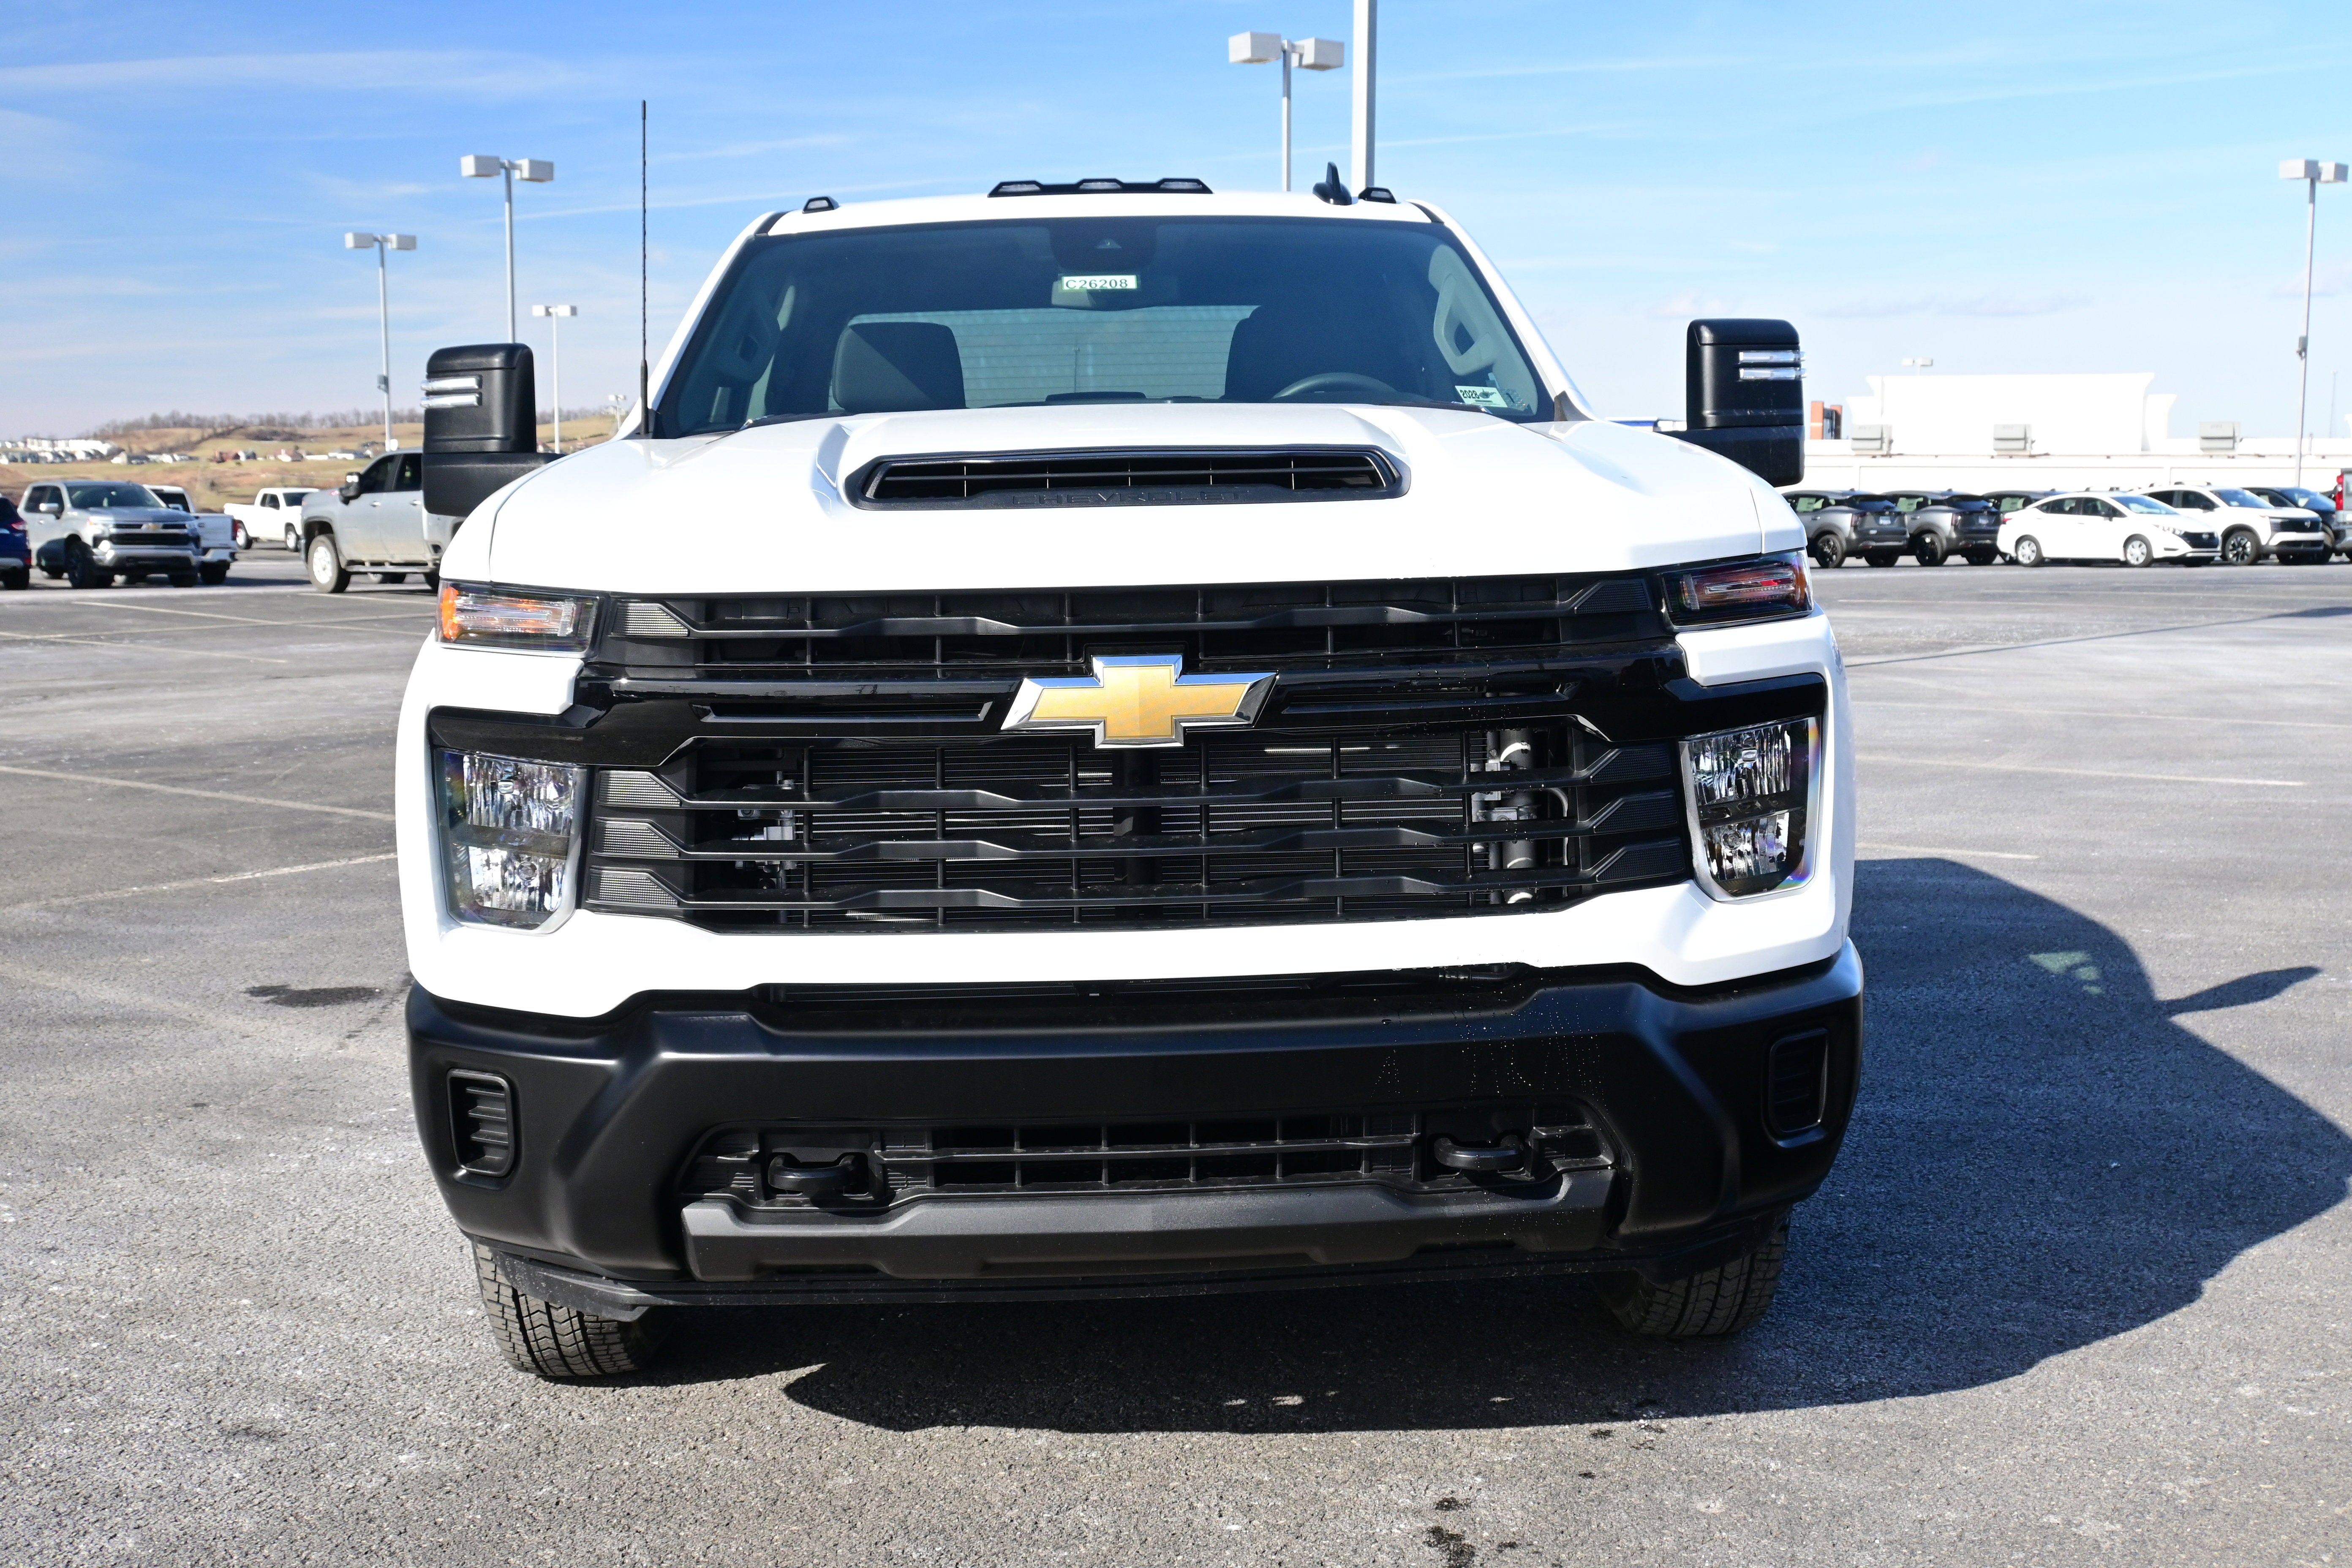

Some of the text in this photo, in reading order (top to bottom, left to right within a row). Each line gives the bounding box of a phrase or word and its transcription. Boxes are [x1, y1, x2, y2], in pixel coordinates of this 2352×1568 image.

[1065, 279, 1128, 289] C26208
[1460, 389, 1480, 399] 2028
[1013, 490, 1249, 504] CHEVROLET
